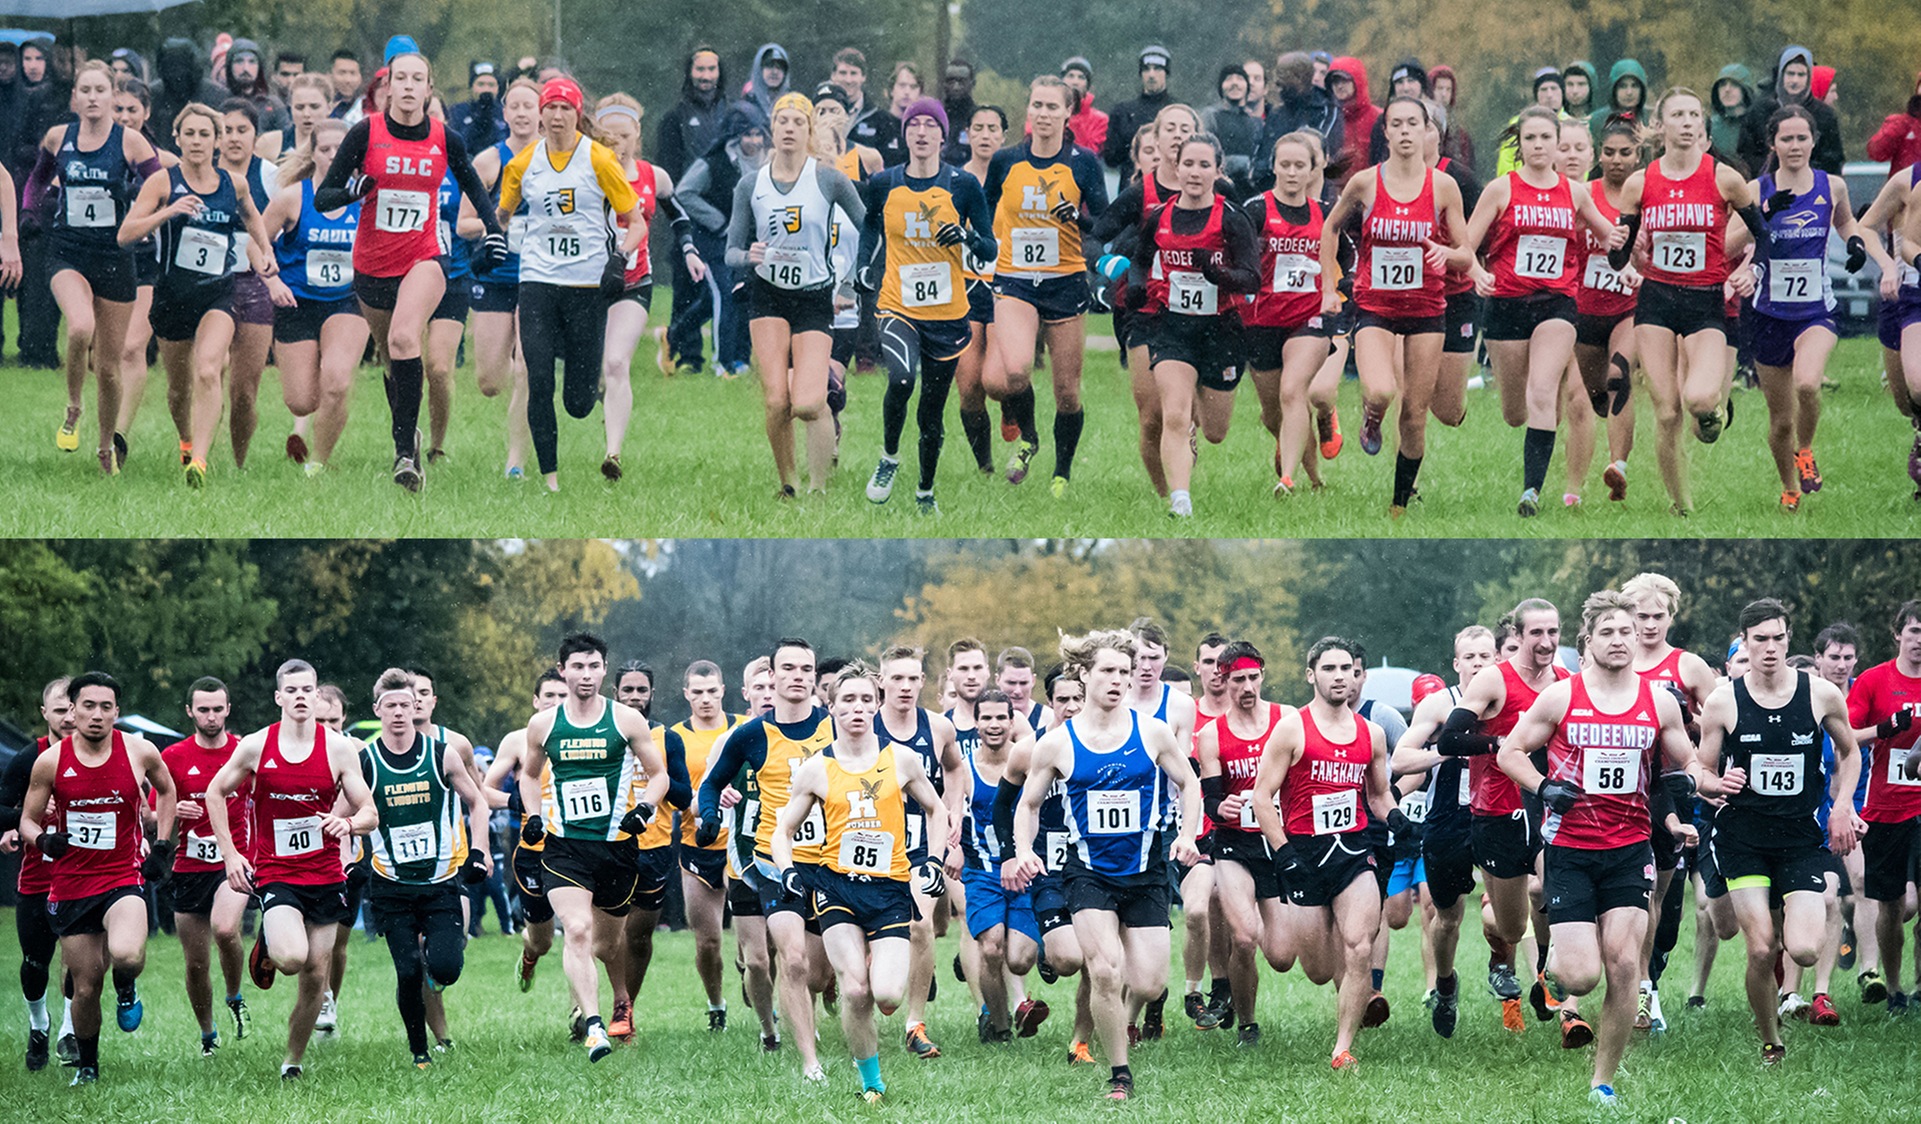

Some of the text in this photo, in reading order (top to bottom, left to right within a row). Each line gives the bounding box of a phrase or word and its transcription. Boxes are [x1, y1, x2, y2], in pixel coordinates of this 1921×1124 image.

[386, 155, 432, 177] SLC
[84, 203, 96, 222] 4
[386, 206, 420, 228] 177
[1514, 204, 1573, 230] FANSHAWE
[1645, 203, 1714, 230] FANSHAWE
[307, 227, 356, 243] SAULT
[1371, 216, 1433, 242] FANSHAWE
[548, 237, 580, 257] 145
[1024, 244, 1046, 263] 82
[1269, 237, 1321, 254] REDEEME
[196, 247, 208, 267] 3
[1525, 252, 1557, 275] 122
[1662, 245, 1696, 269] 123
[320, 263, 341, 283] 43
[769, 263, 801, 286] 146
[1287, 270, 1306, 288] 53
[1381, 265, 1415, 284] 120
[915, 280, 938, 302] 84
[1784, 276, 1808, 297] 72
[1181, 290, 1203, 310] 54
[560, 738, 607, 749] FLEMING
[1567, 723, 1656, 750] REDEEMER
[560, 748, 608, 760] KNIGHTS
[1227, 756, 1262, 779] FANS
[384, 780, 430, 796] FLEMING
[1598, 767, 1625, 789] 58
[1760, 771, 1795, 791] 143
[69, 795, 125, 808] SENECA
[189, 791, 239, 799] SEA
[269, 790, 320, 802] SENECA
[385, 792, 431, 807] KNIGHTS
[570, 794, 602, 816] 116
[1096, 808, 1130, 829] 101
[1322, 806, 1352, 829] 129
[1406, 802, 1428, 819] 14
[79, 826, 102, 845] 37
[288, 830, 311, 851] 40
[197, 843, 218, 860] 33
[399, 837, 429, 858] 117
[853, 845, 878, 868] 85
[1055, 848, 1065, 866] 2
